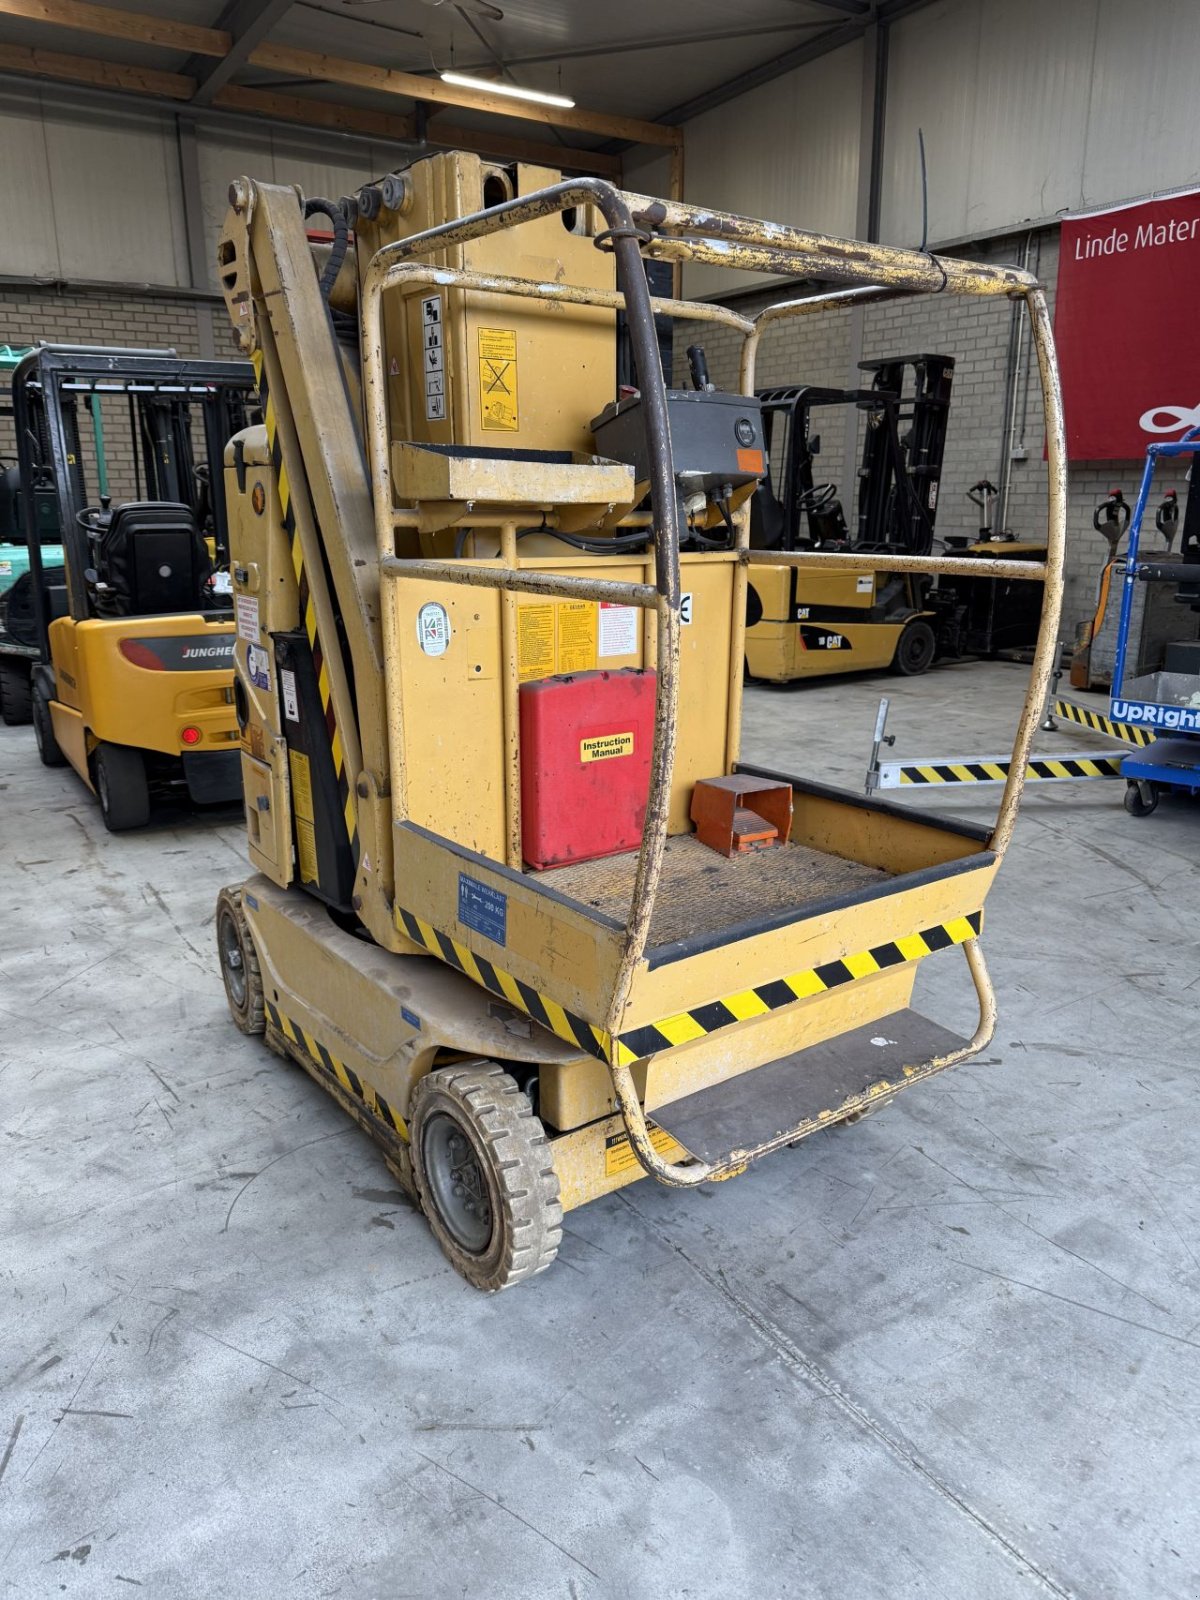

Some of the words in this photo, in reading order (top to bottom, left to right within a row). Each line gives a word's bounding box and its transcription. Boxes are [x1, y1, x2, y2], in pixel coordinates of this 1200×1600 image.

[1075, 228, 1128, 260] Linde
[1134, 218, 1200, 249] Mater
[797, 607, 810, 619] CAT
[826, 635, 842, 649] CAT
[583, 736, 631, 750] Instruction
[592, 746, 623, 758] Manual
